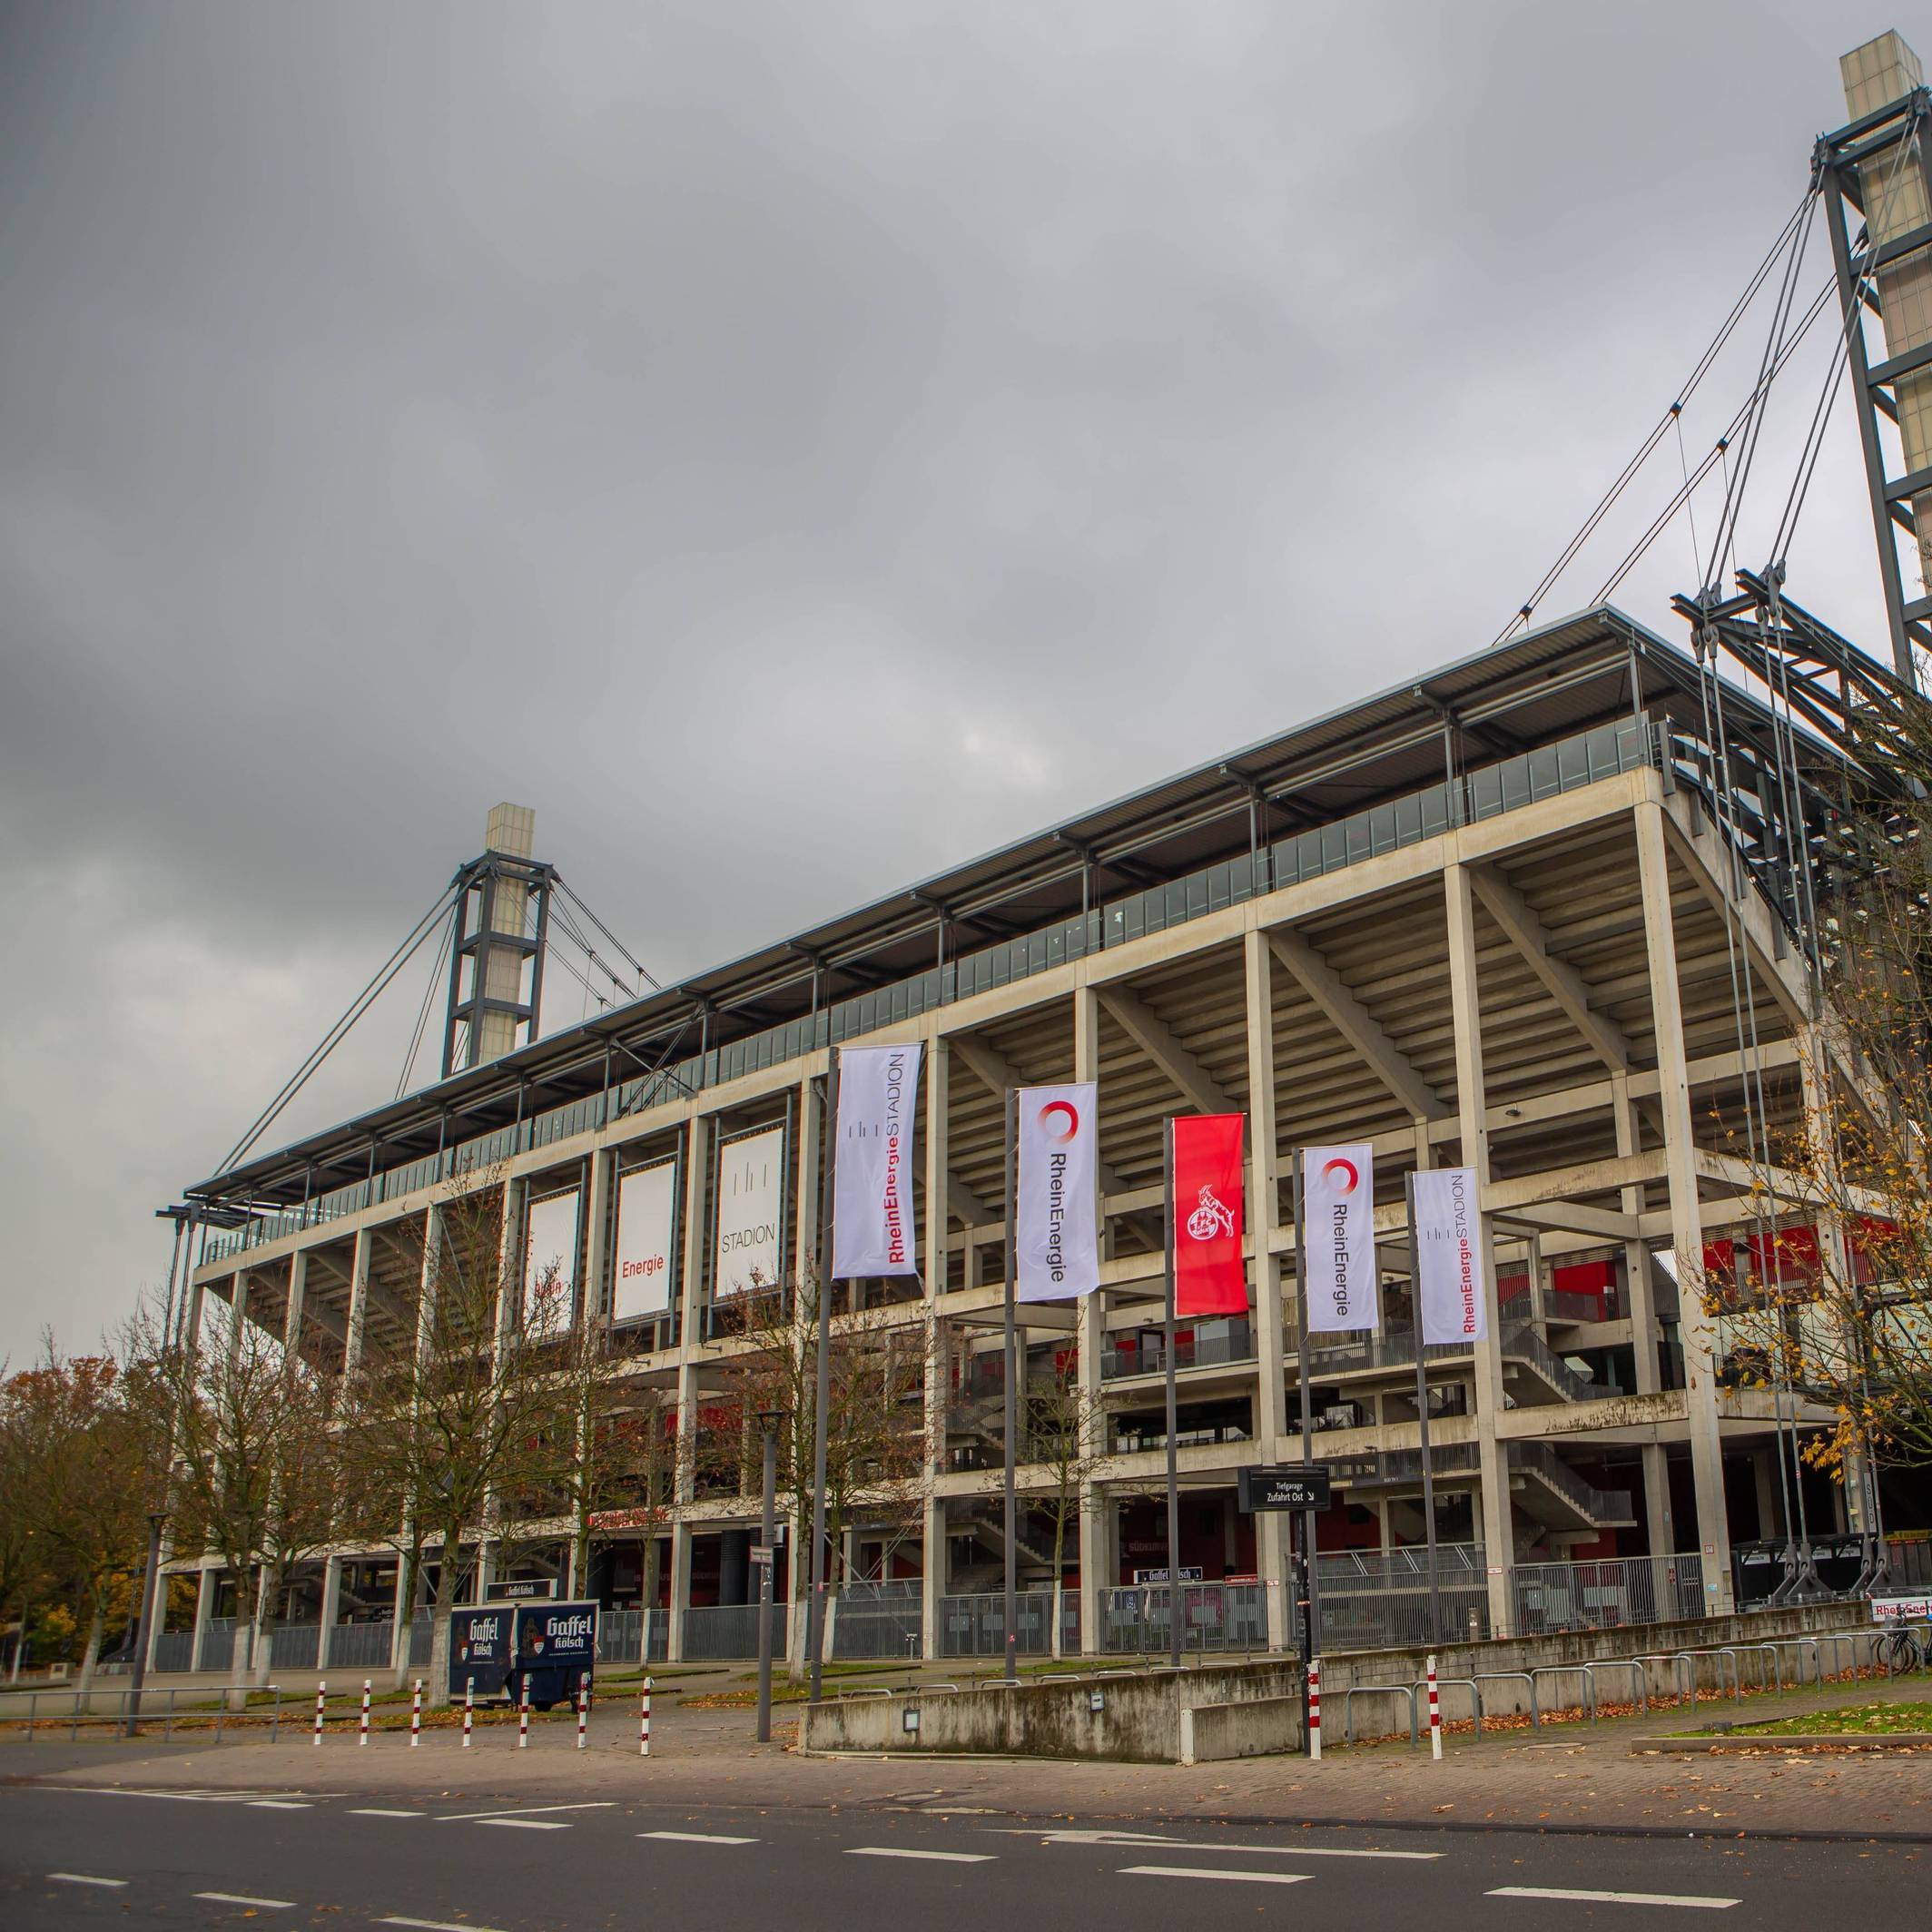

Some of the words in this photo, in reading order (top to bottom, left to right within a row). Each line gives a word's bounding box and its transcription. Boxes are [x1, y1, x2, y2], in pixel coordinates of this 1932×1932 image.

[883, 1053, 905, 1264] RheinEnergieSTADION
[1049, 1153, 1067, 1283] RheinEnergie
[721, 1223, 775, 1254] STADION
[622, 1253, 665, 1278] Energie
[1333, 1204, 1349, 1316] RheinEnergie
[1451, 1175, 1476, 1334] RheinEnergieSTADION
[1267, 1492, 1291, 1502] Zufahrt
[1292, 1492, 1304, 1502] Ost
[1276, 1482, 1304, 1492] Tiefgarage
[469, 1616, 499, 1641] Gaffel
[547, 1615, 593, 1638] Gaffel
[473, 1642, 493, 1657] Kölsch
[555, 1636, 584, 1649] Kölsch
